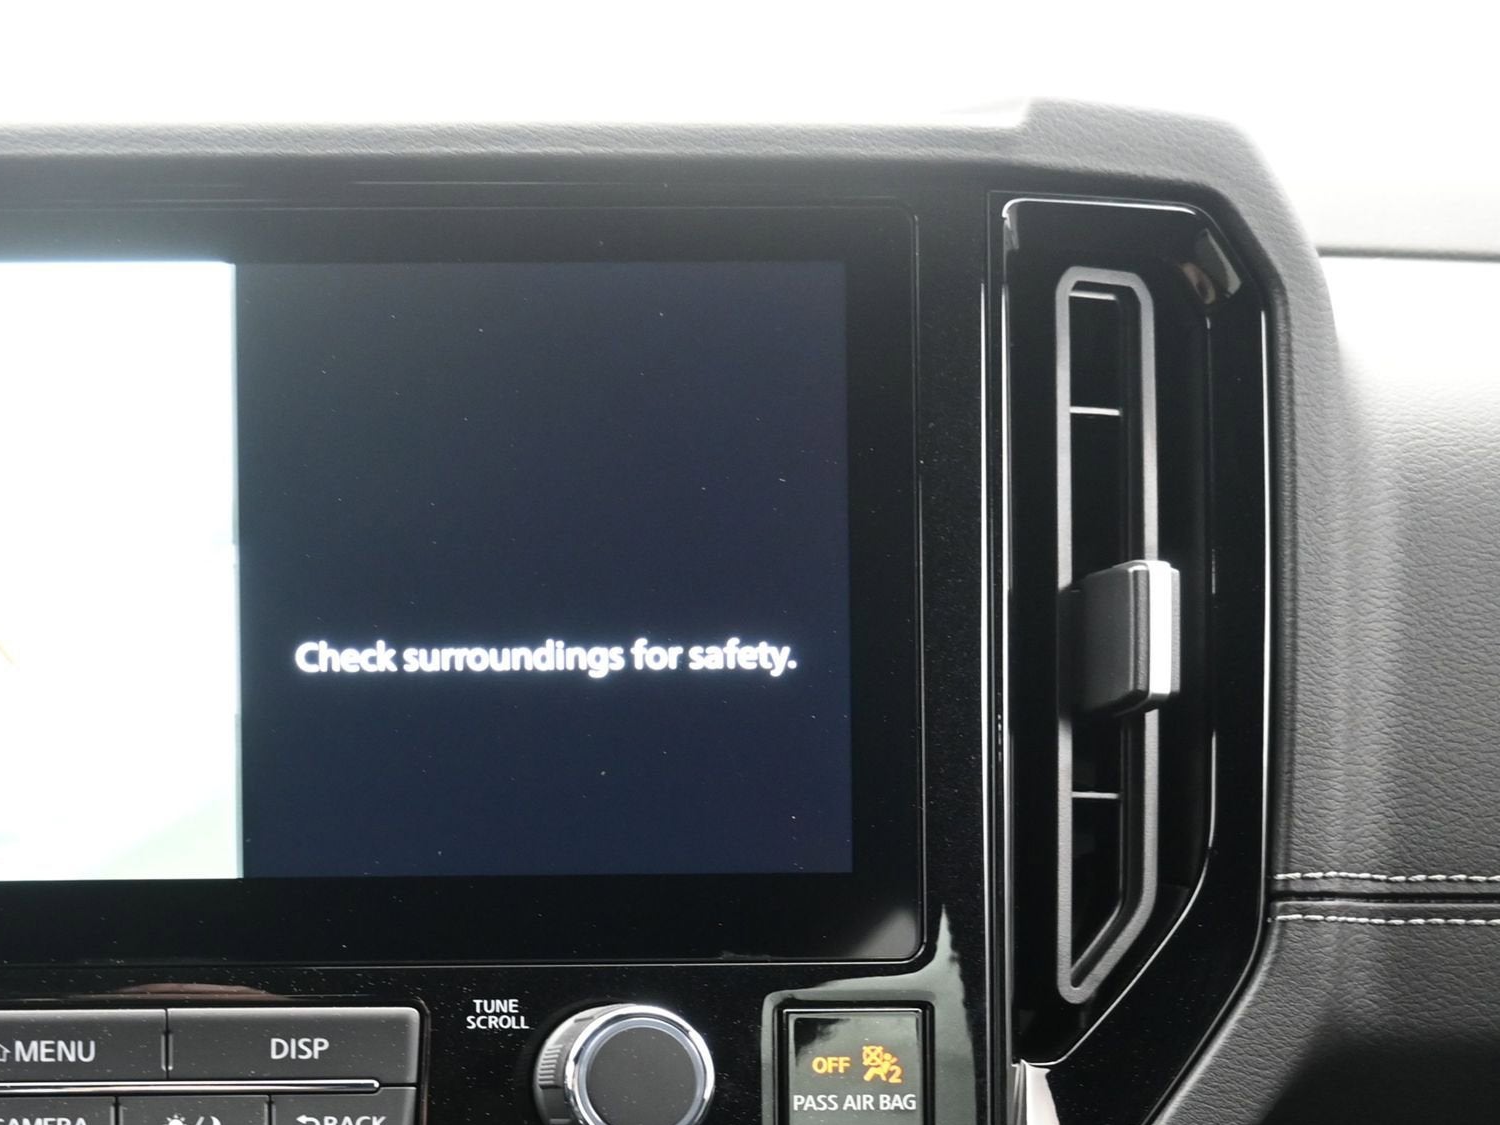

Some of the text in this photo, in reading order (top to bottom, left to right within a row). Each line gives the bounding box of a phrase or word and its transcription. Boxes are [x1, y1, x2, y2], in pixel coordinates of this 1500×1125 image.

[295, 639, 797, 678] Check surroundings for safety.
[472, 999, 519, 1014] TUNE
[466, 1014, 530, 1030] SCROLL
[13, 1040, 97, 1064] MENU
[269, 1037, 331, 1061] DISP
[811, 1055, 851, 1075] OFF
[792, 1093, 918, 1112] PASS AIR BAG
